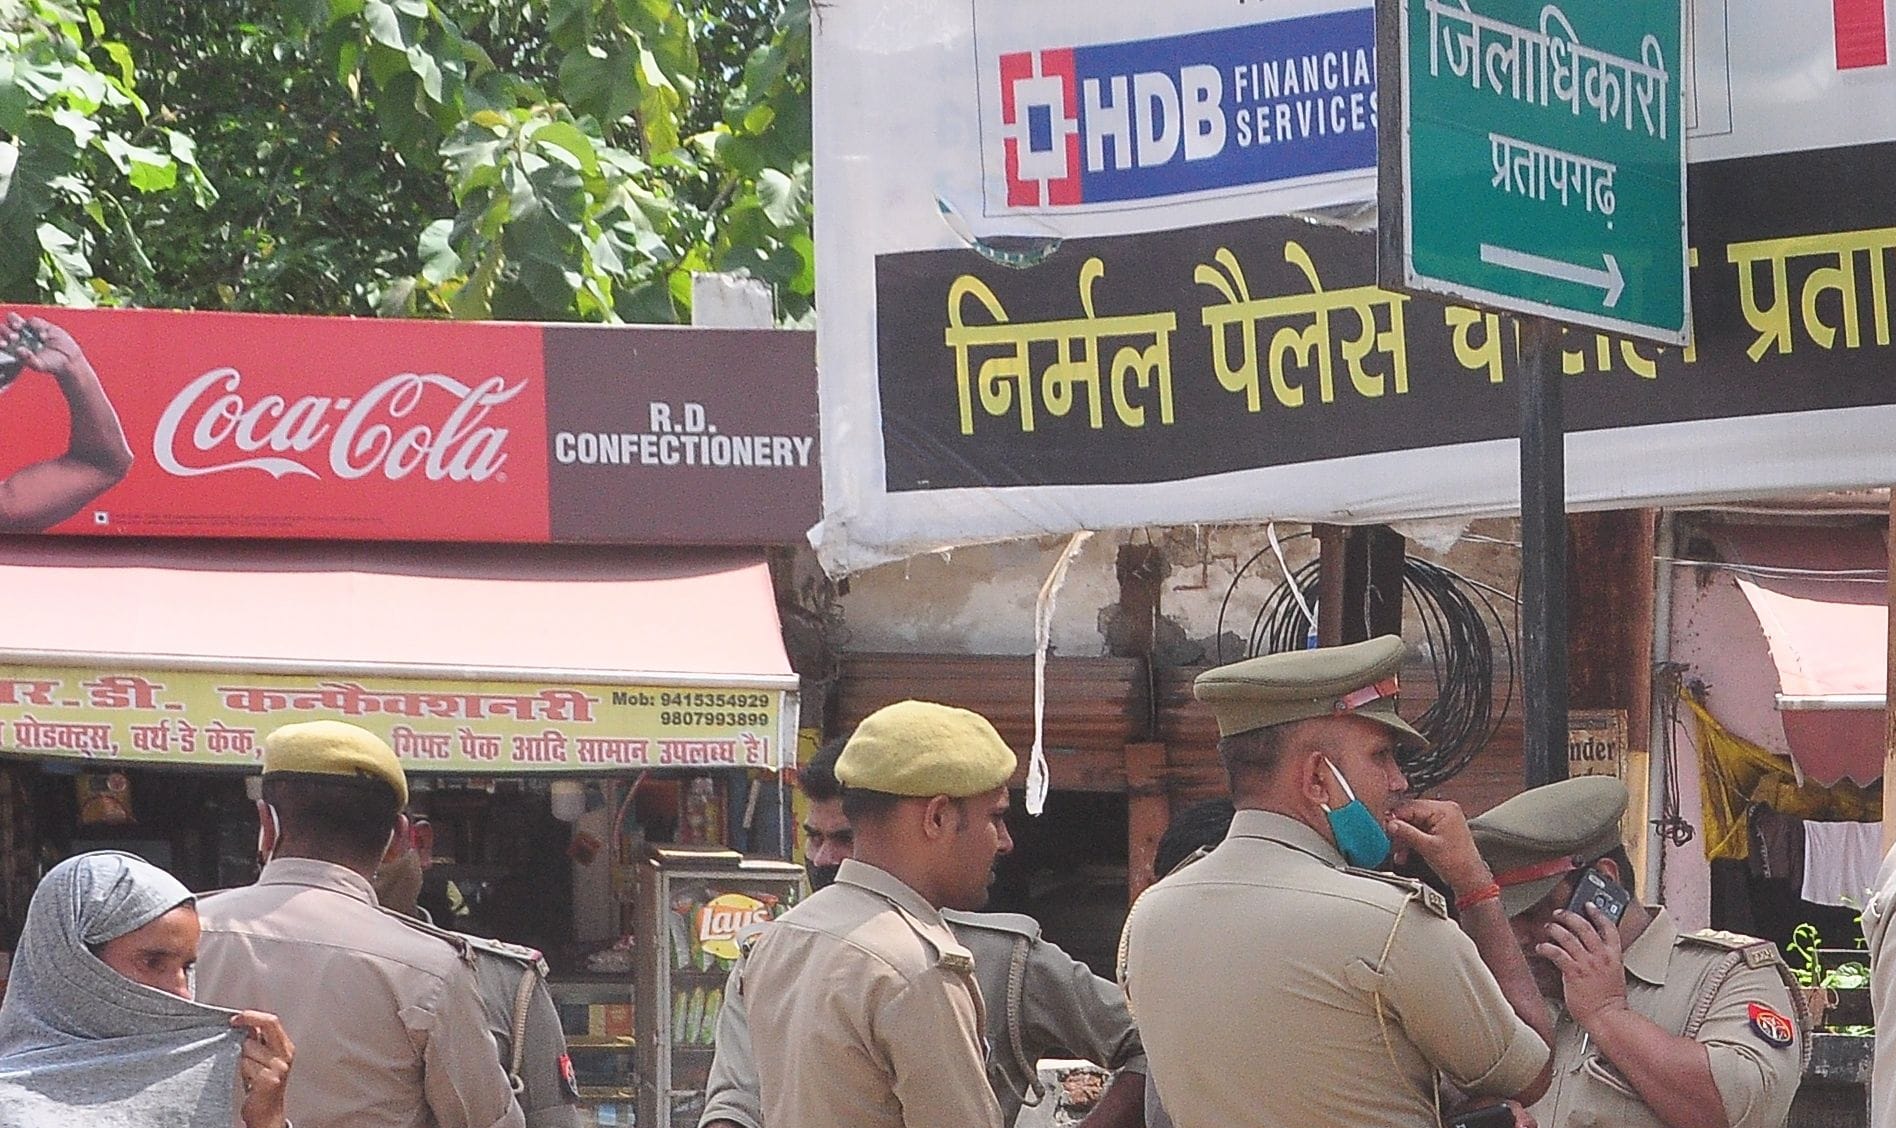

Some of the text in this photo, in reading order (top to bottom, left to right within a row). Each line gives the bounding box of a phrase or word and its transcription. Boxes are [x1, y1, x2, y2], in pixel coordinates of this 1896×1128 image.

[1425, 0, 1669, 140] जिलाधिकारी
[1083, 64, 1227, 173] HDB
[1489, 132, 1617, 230] प्रतापगढ़
[945, 257, 1177, 435] निर्मल
[1194, 241, 1411, 412] पैलेस
[153, 366, 530, 483] Coca-Cola
[555, 432, 813, 467] CONFECTIONERY
[650, 402, 717, 433] R.D.
[612, 691, 769, 708] Mob: 9415354929
[660, 711, 769, 727] 9807993899
[205, 721, 262, 759] केक,
[457, 727, 501, 760] पैक
[512, 730, 567, 763] आदि
[576, 738, 649, 764] सामान
